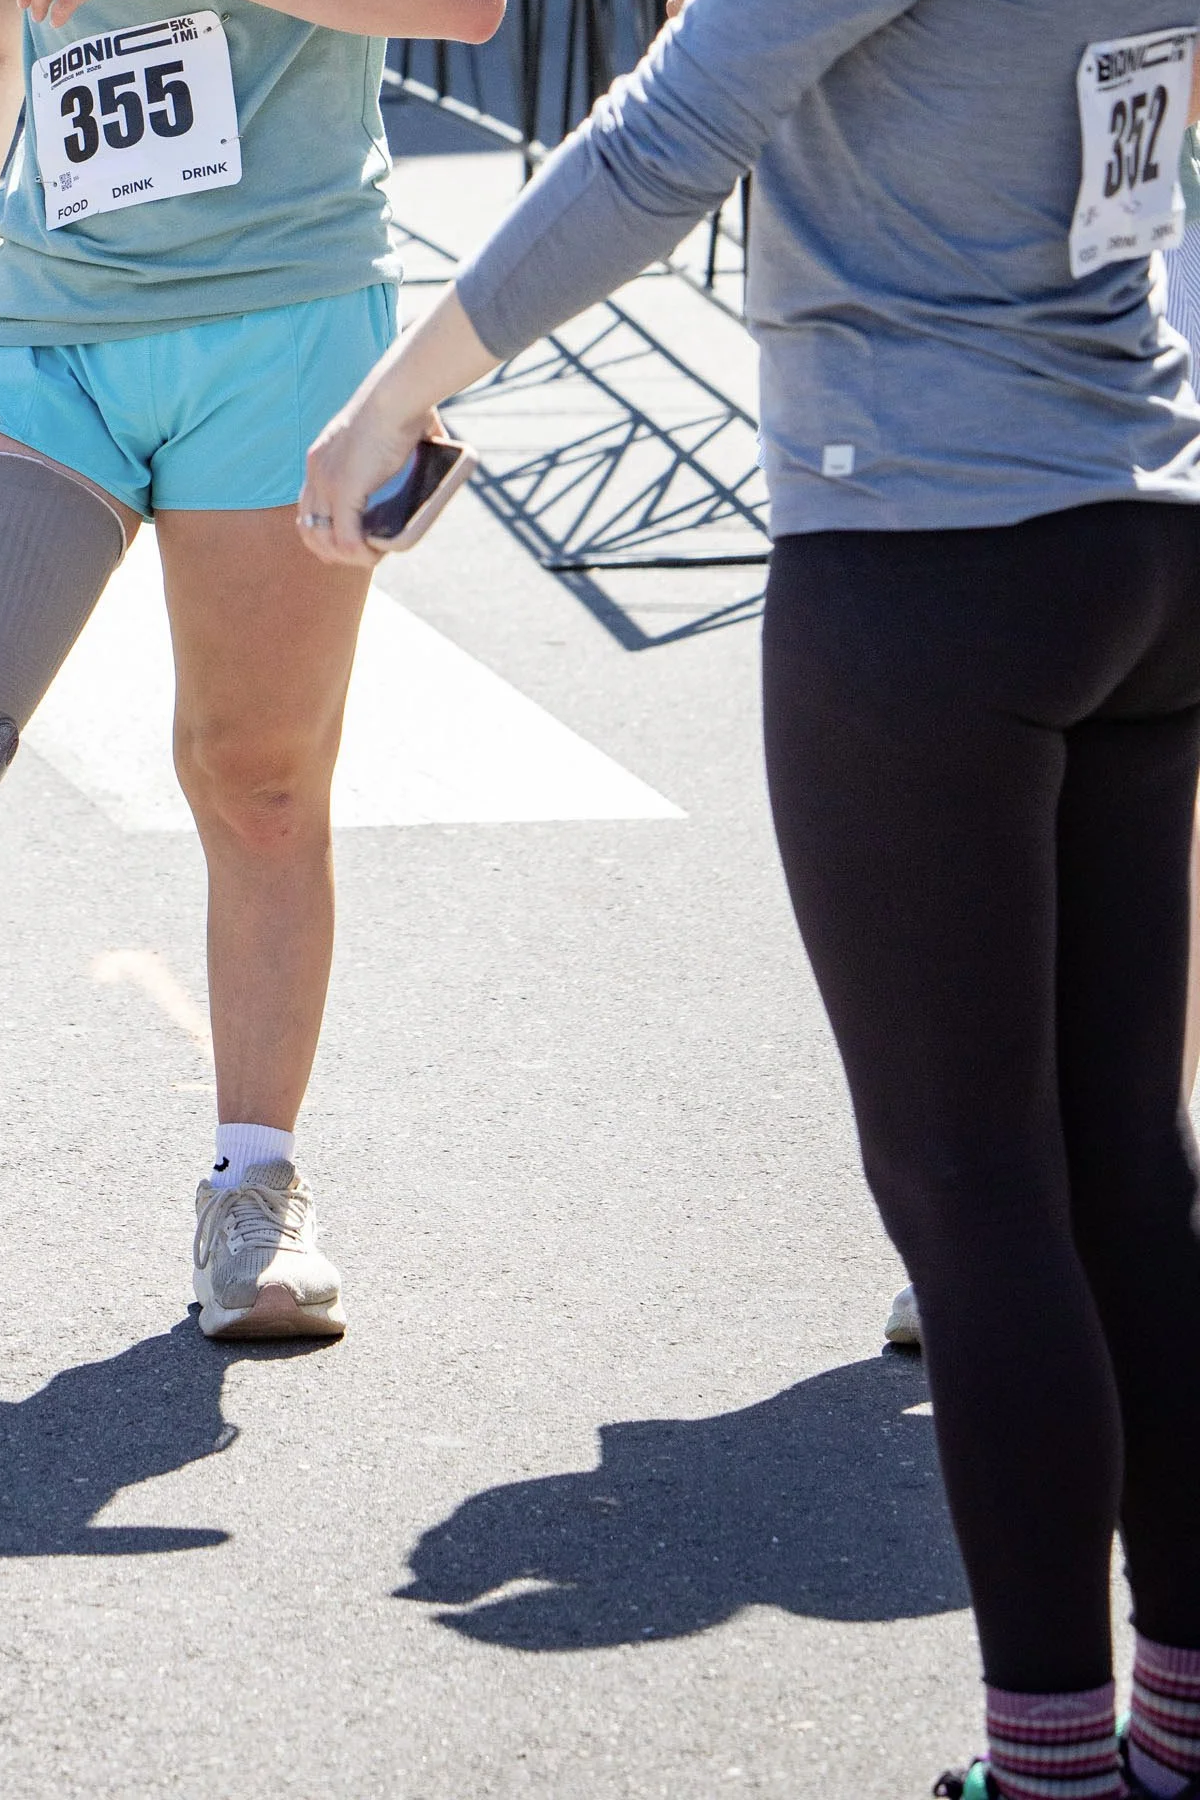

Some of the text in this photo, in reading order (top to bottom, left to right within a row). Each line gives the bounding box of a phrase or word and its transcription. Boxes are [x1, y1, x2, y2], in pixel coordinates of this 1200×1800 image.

[49, 22, 173, 84] BIONIC
[60, 60, 194, 164] 355
[1103, 84, 1169, 199] 352
[58, 162, 228, 220] FOOD DRINK DRINK
